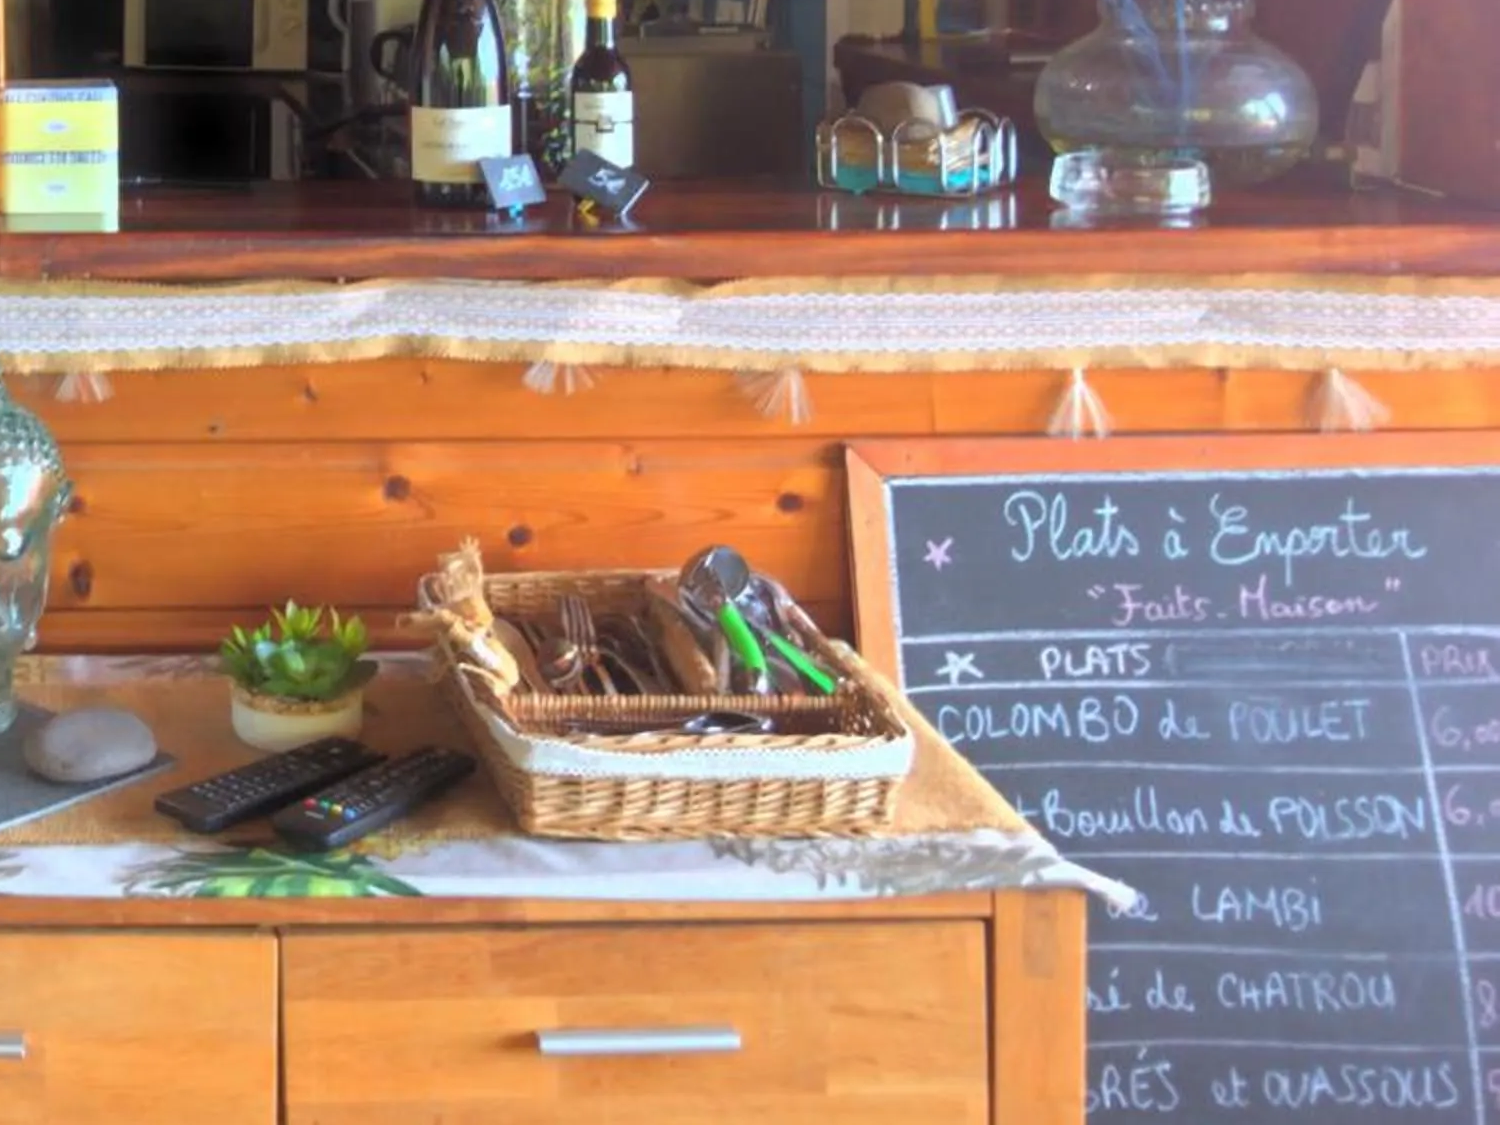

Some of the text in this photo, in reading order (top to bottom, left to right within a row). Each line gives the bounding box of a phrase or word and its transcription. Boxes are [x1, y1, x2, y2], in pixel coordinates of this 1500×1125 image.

[1005, 490, 1140, 562] Plats
[1162, 508, 1189, 559] à
[1040, 643, 1153, 681] PLATS
[937, 695, 1372, 745] COLOMBO de POULET
[1220, 798, 1262, 838] de
[1146, 968, 1196, 1013] de
[1217, 970, 1397, 1014] CHATROU
[1210, 1066, 1249, 1108] et
